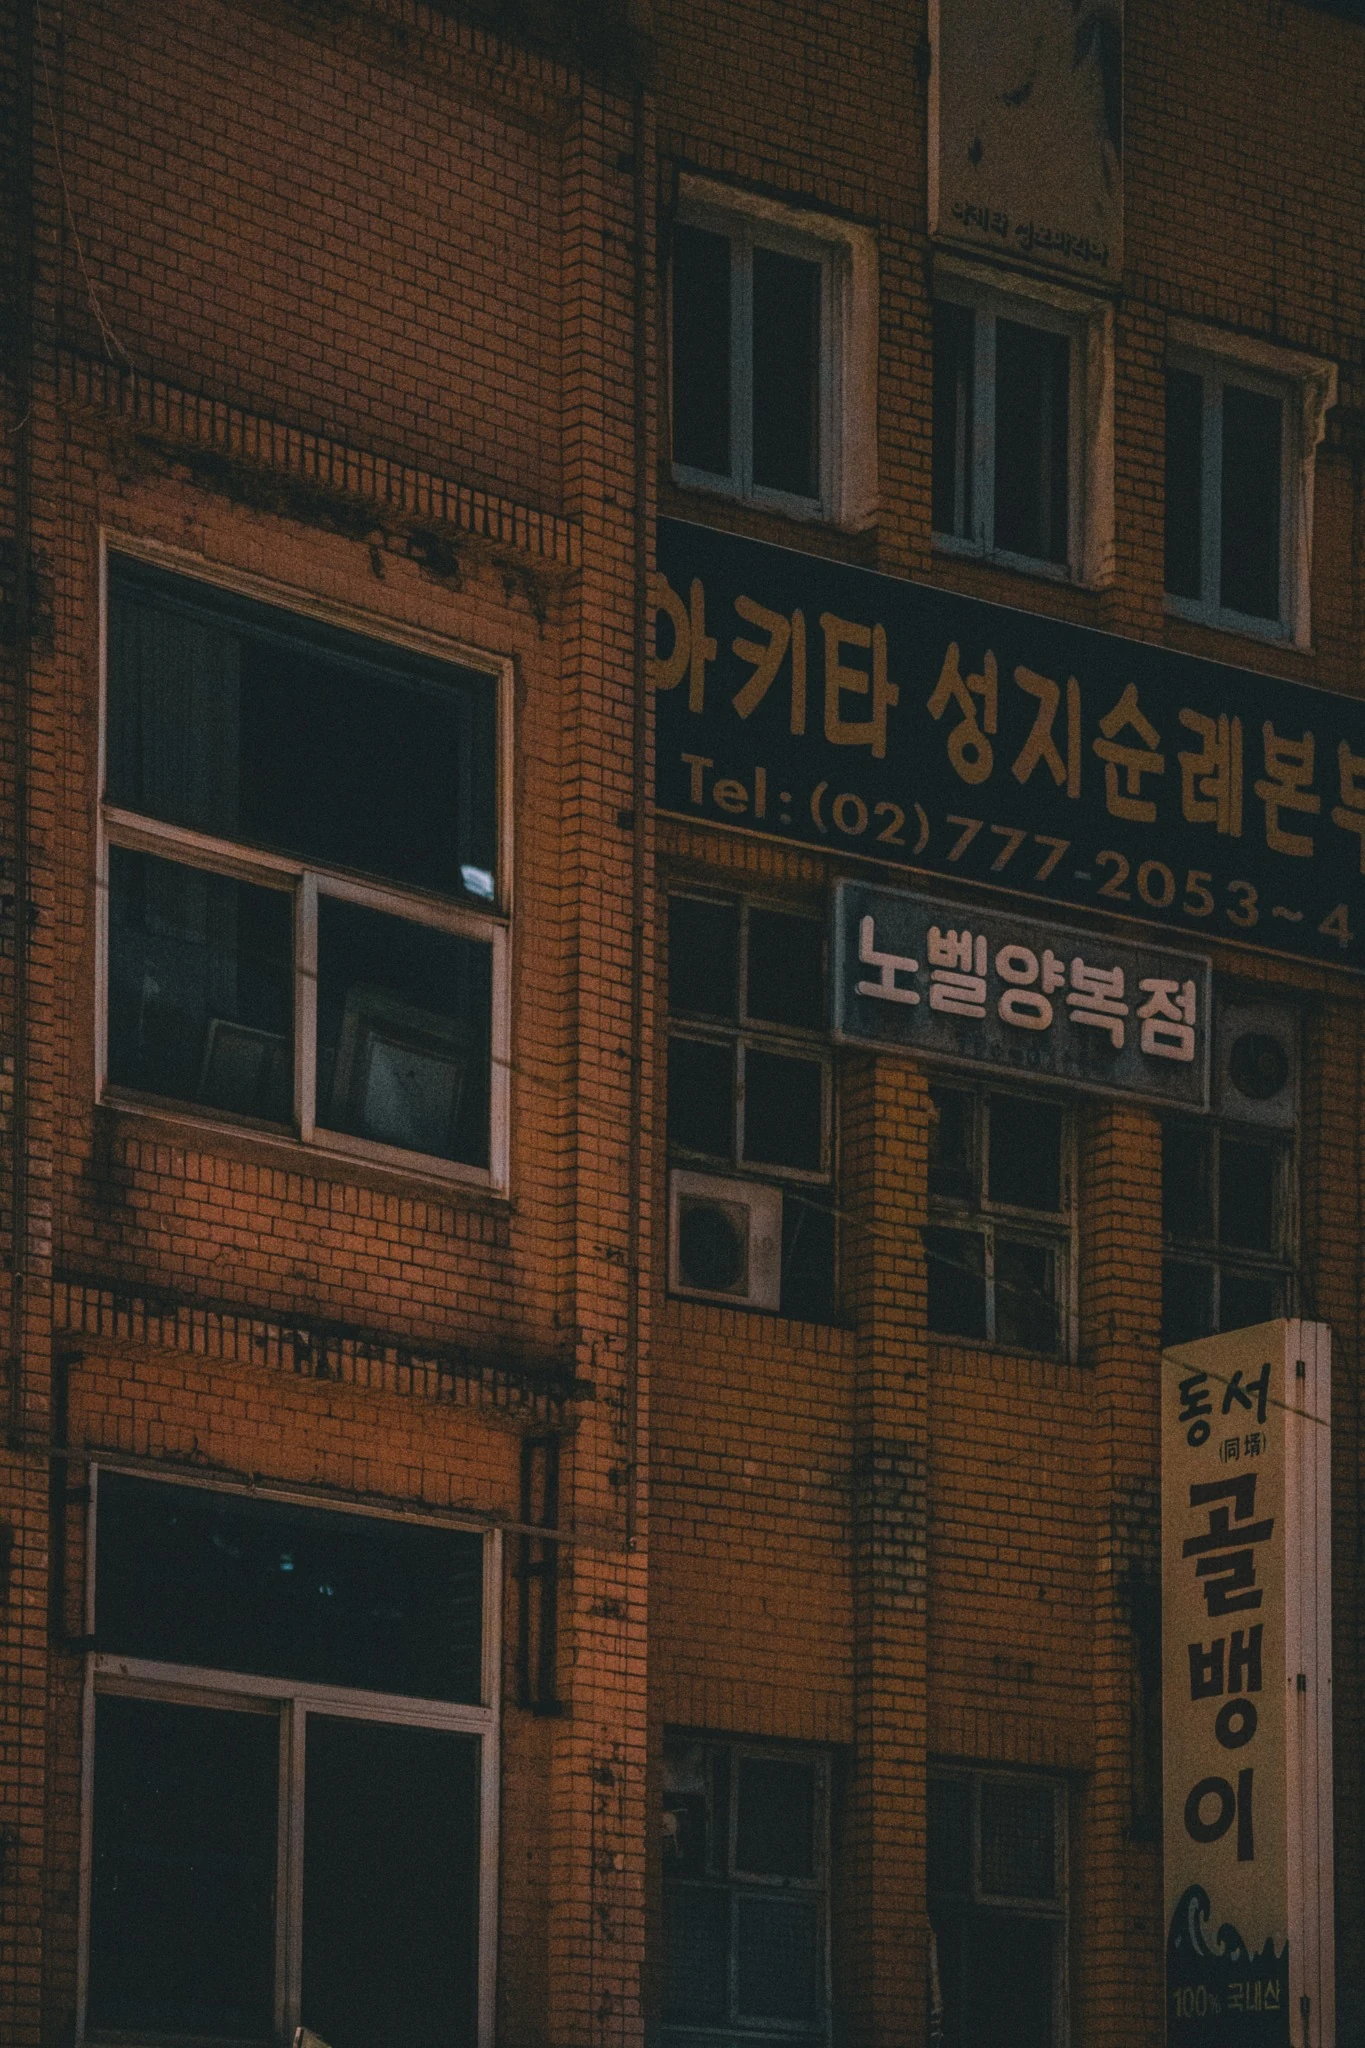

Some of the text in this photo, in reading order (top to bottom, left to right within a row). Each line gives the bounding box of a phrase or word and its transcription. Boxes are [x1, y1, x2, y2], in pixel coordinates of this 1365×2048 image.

[655, 572, 899, 758] 아키타
[855, 914, 1197, 1062] 노벨양복점
[1178, 1362, 1271, 1447] 동서
[1182, 1473, 1274, 1862] 골뱅이
[1172, 1978, 1281, 2018] 100% 국내산
